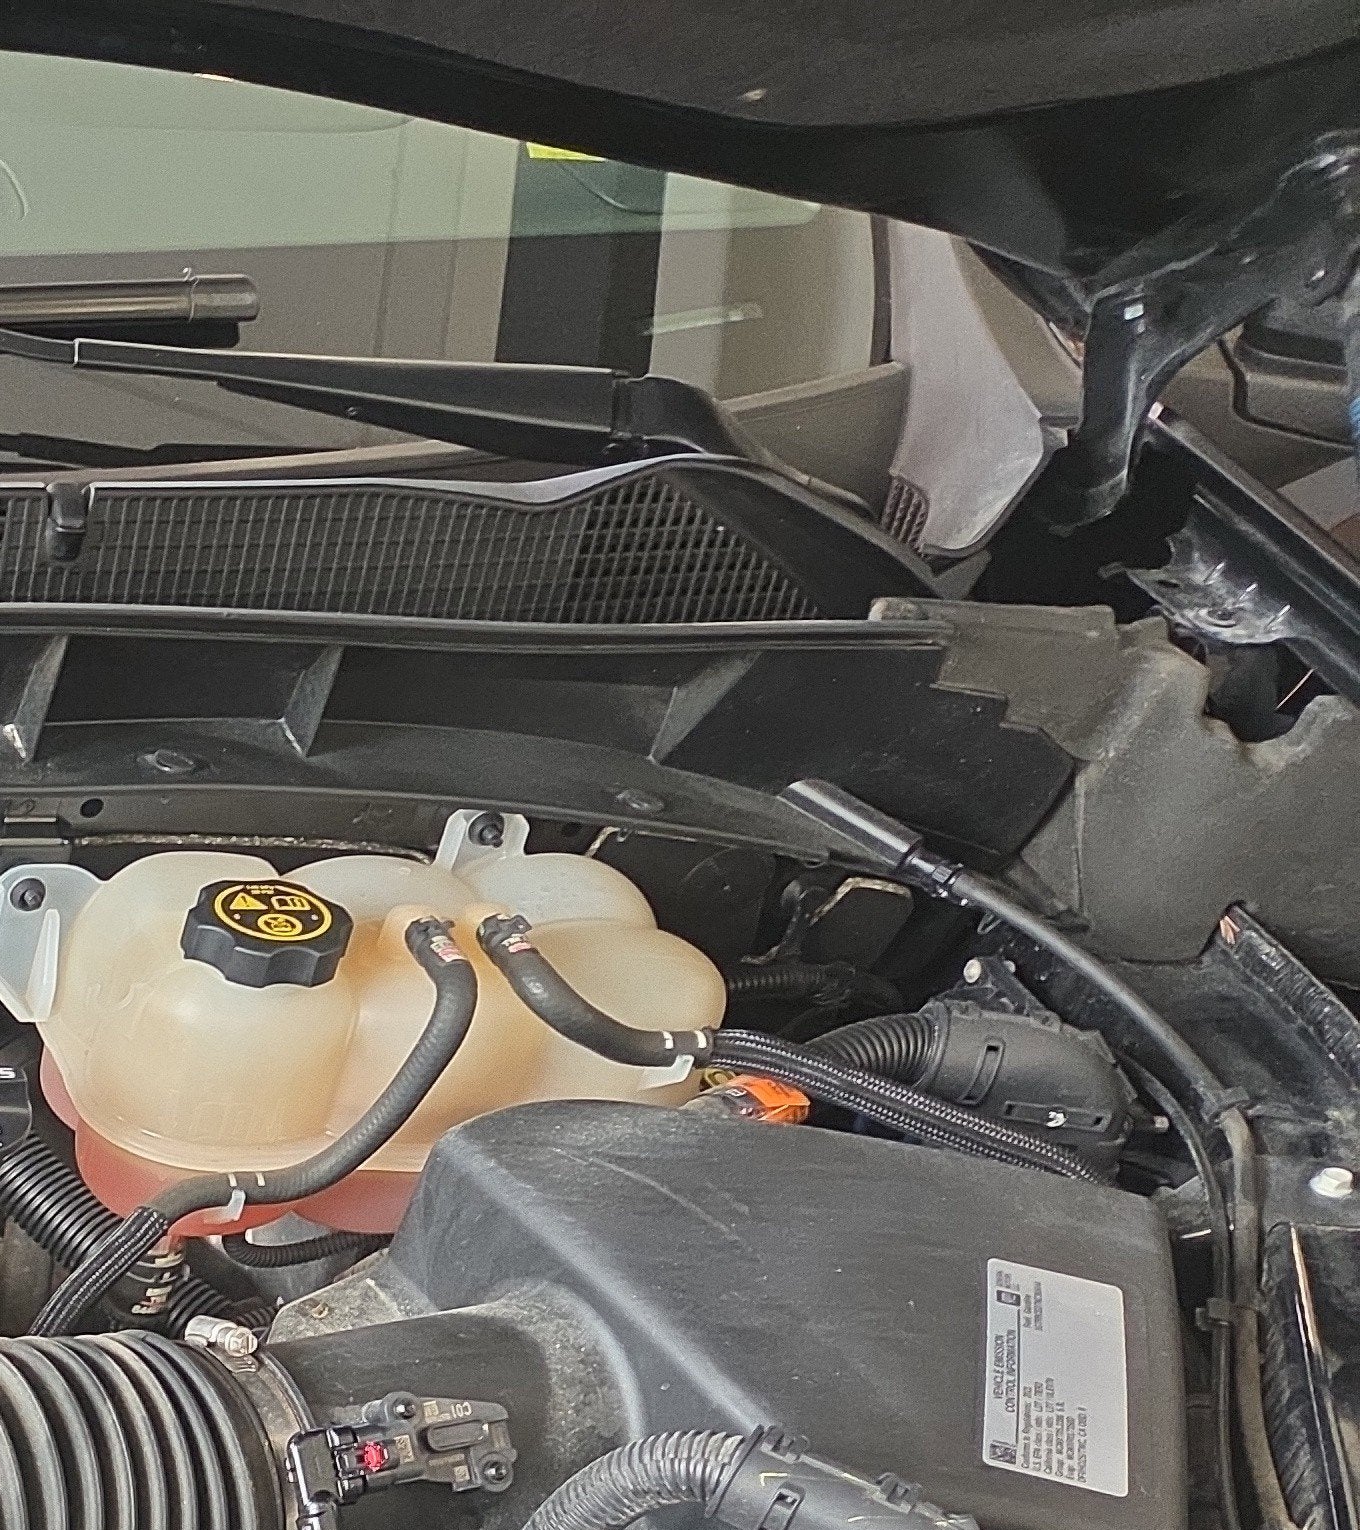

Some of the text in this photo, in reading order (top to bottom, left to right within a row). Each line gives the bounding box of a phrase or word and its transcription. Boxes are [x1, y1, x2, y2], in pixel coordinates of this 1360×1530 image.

[994, 1334, 1004, 1399] VEHICLE EMISSION
[1006, 1329, 1016, 1413] CONTROL INFORMATION
